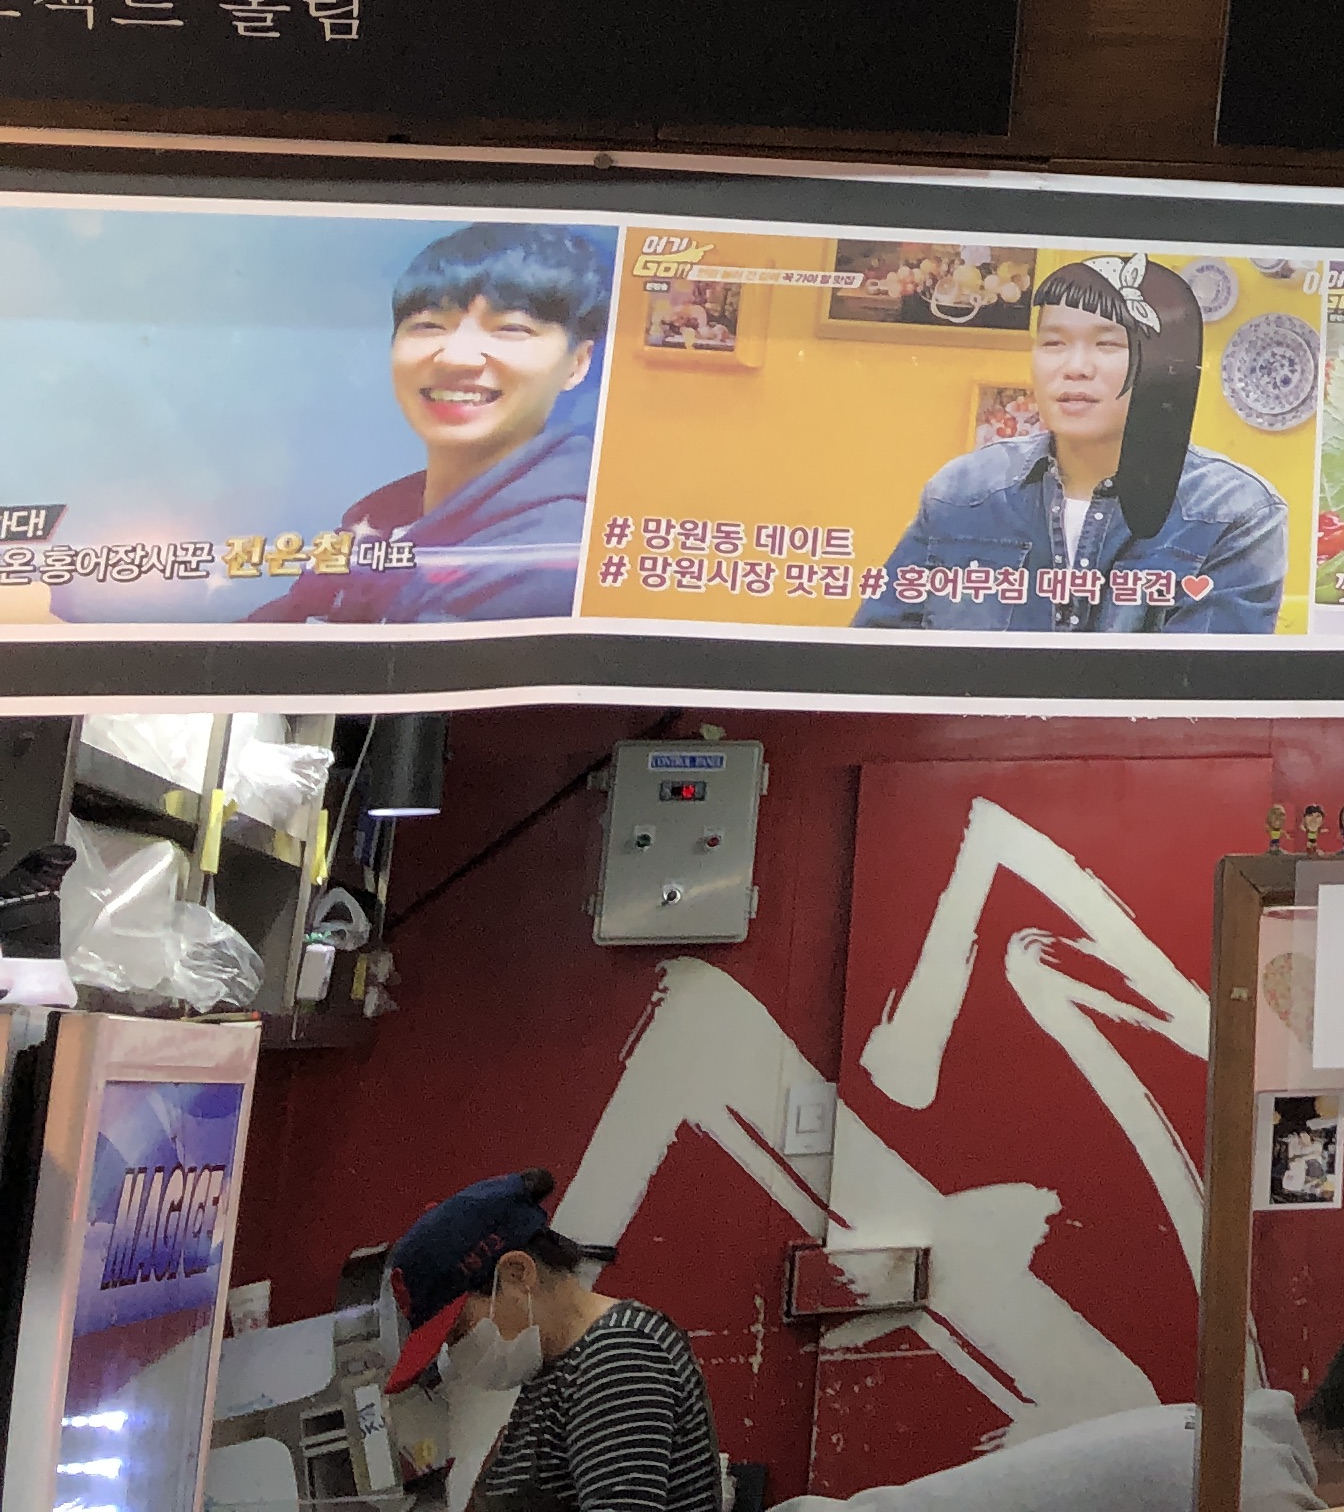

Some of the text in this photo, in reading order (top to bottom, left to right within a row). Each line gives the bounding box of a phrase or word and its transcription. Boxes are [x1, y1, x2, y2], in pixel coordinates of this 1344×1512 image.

[39, 542, 215, 584] 홍어장사꾼
[221, 530, 356, 579] 전은철
[358, 538, 417, 573] 대표
[641, 515, 744, 554] 망원동
[754, 523, 854, 560] 데이트
[638, 555, 776, 595] 망원시장
[784, 561, 850, 599] 맛집
[895, 566, 1029, 606] 홍어무침
[1037, 568, 1102, 606] 대박
[1108, 569, 1174, 606] 발견
